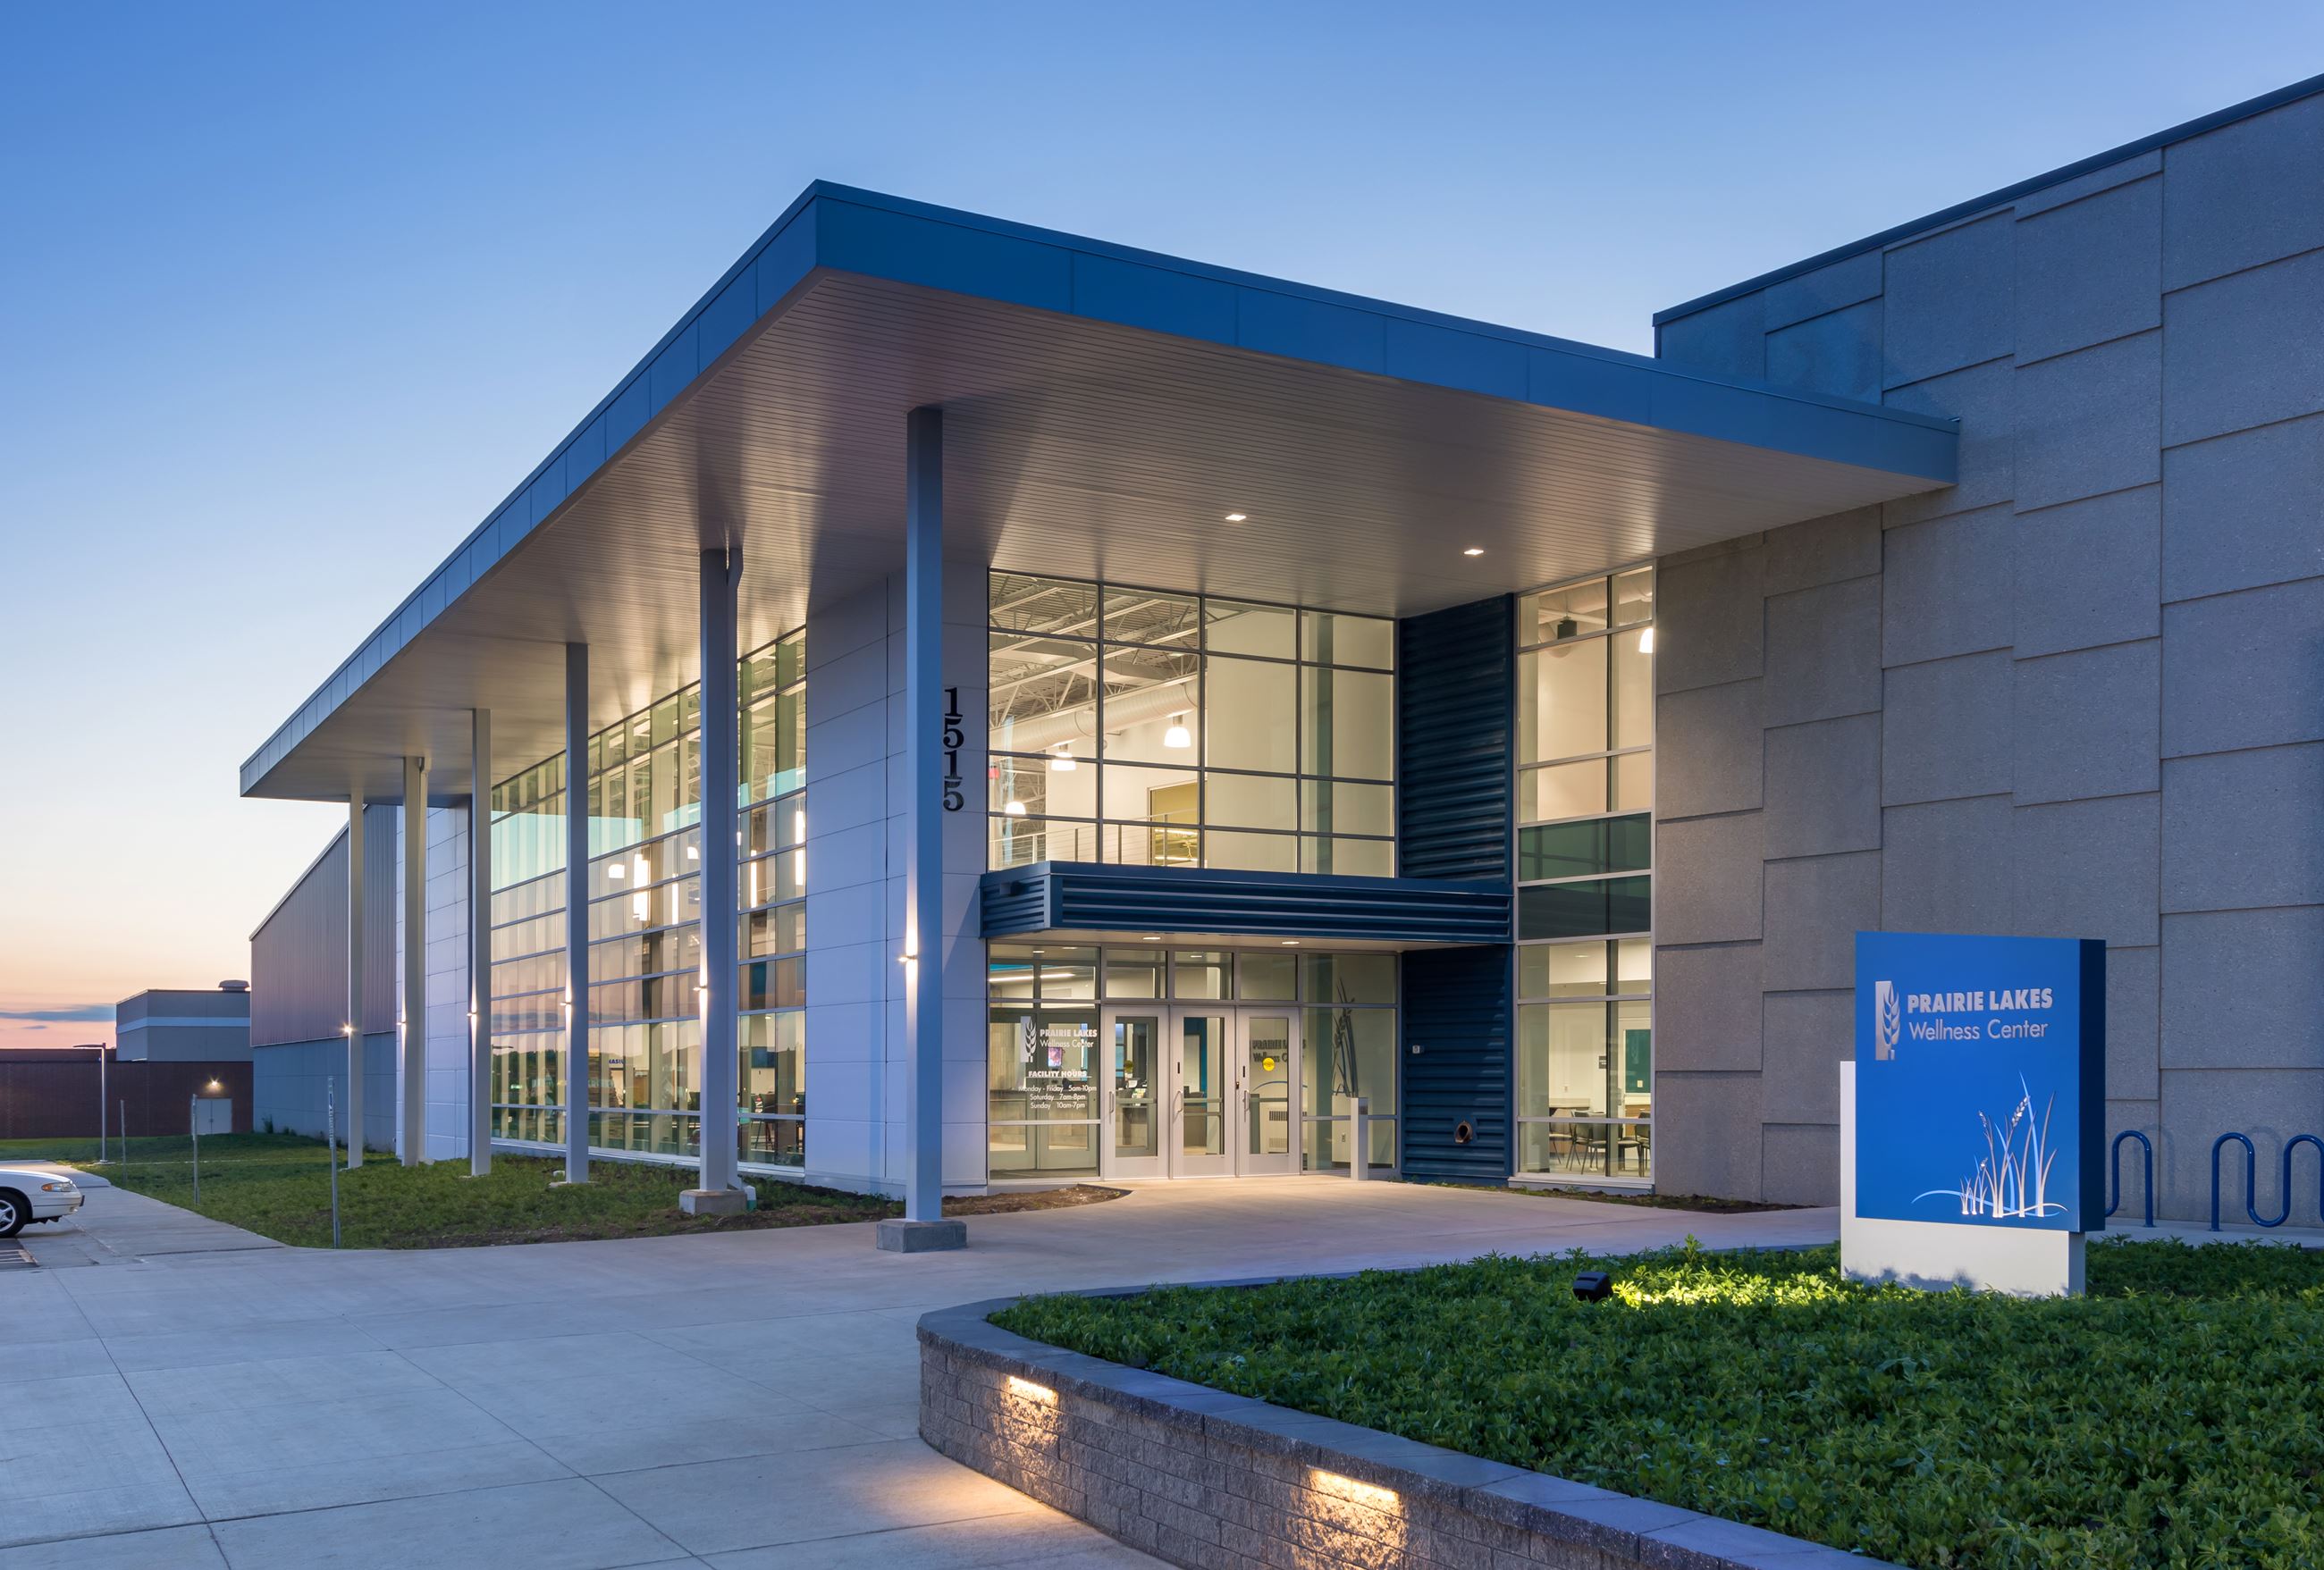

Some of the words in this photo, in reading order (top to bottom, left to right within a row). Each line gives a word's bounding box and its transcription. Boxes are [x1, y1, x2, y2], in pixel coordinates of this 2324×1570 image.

[943, 687, 964, 811] 1515
[1907, 991, 1984, 1013] PRAIRIE
[1989, 987, 2053, 1011] LAKES
[1040, 1028, 1071, 1037] PRAIRIE
[1074, 1028, 1098, 1037] LAKES
[1908, 1019, 1981, 1041] Wellness
[1987, 1019, 2049, 1039] Center
[1040, 1038, 1070, 1047] Wellness
[1073, 1039, 1093, 1047] Center
[1019, 1085, 1041, 1093] Monday
[1047, 1085, 1064, 1093] Friday
[1030, 1093, 1054, 1101] Saturday
[1059, 1093, 1086, 1101] 7am-8pm
[1030, 1102, 1051, 1110] Sunday
[1057, 1102, 1085, 1110] 10am-7pm
